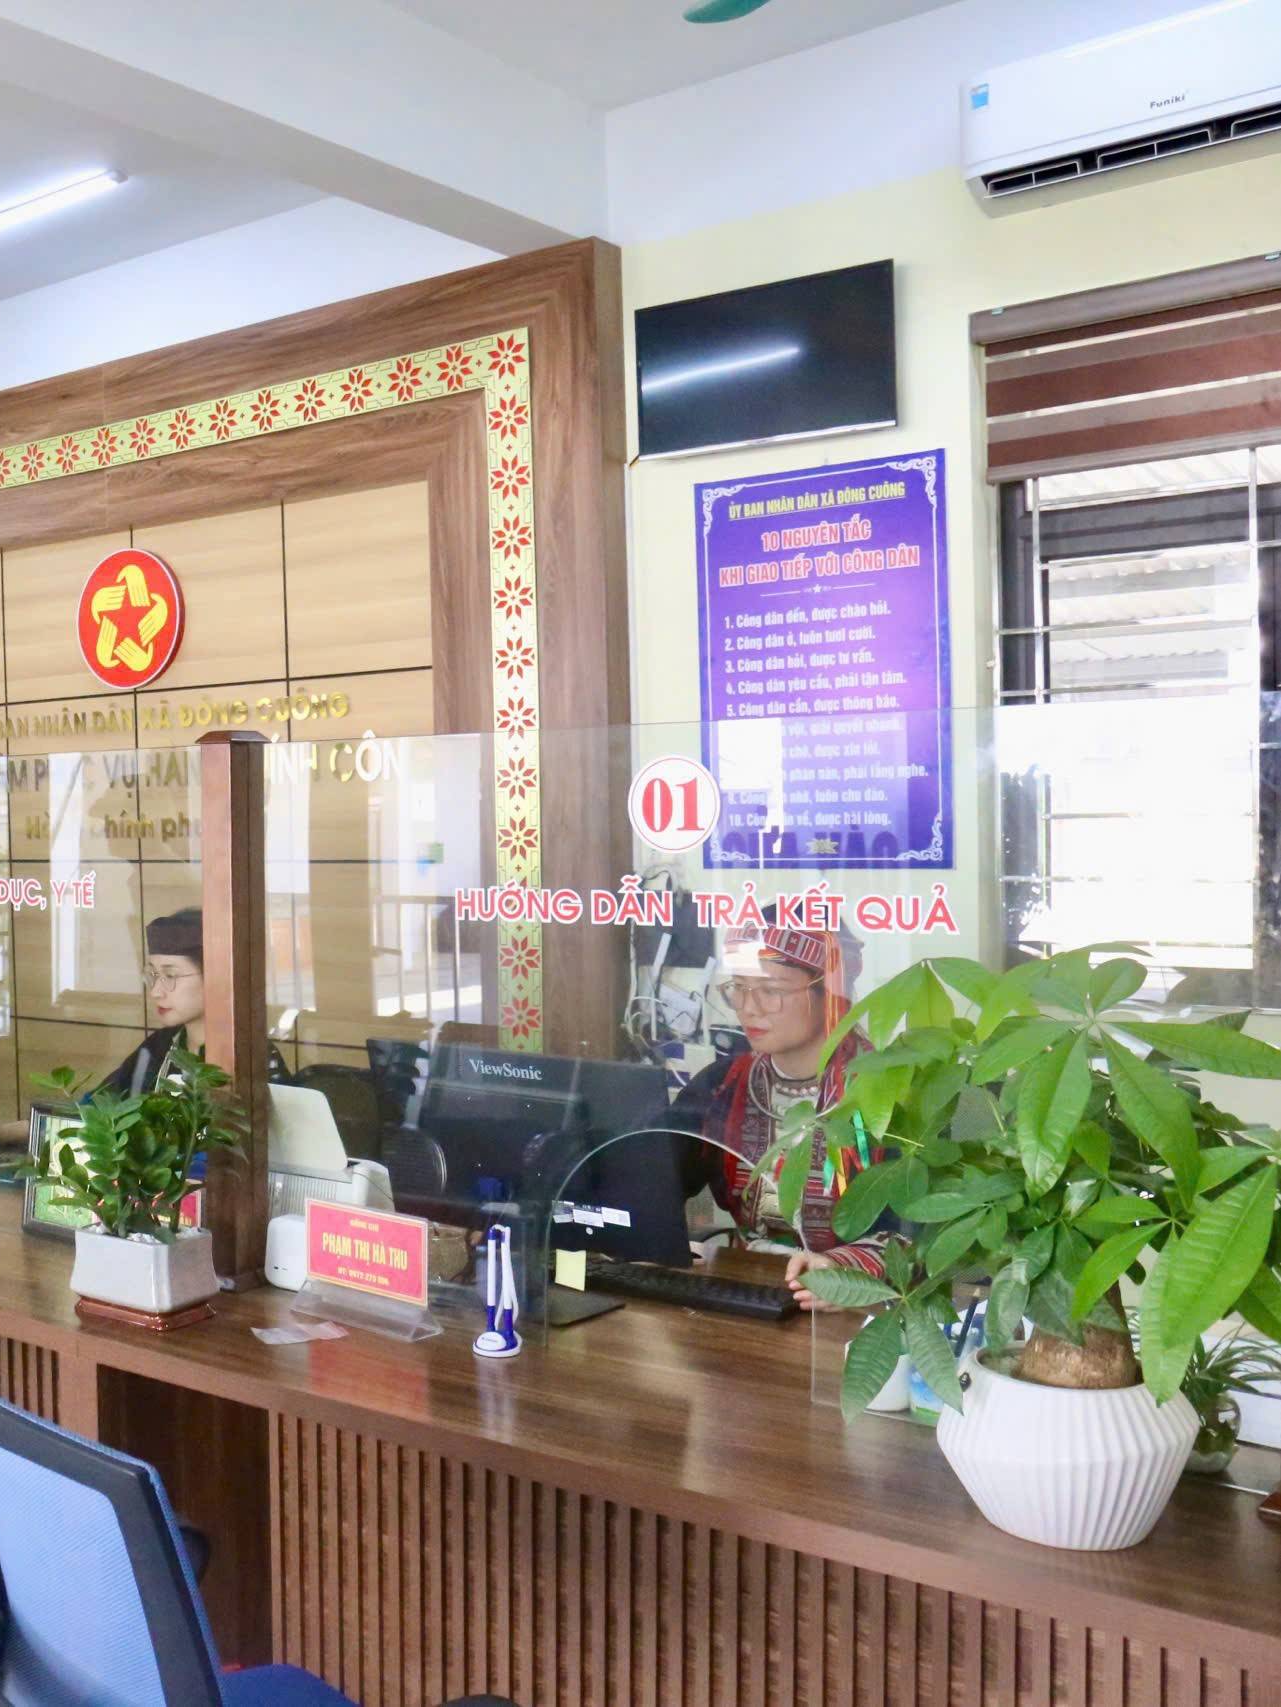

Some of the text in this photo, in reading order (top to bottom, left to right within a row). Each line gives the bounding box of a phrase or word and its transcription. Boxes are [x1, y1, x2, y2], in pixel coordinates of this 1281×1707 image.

[1150, 93, 1185, 109] Funiki
[744, 503, 764, 516] BAN
[767, 496, 795, 514] NHÂN
[797, 492, 818, 510] DÂN
[762, 513, 872, 551] 10 NGUYÊN TẮC
[720, 543, 920, 587] KHI GIAO TIẾP VỚI CÔNG DÂN
[736, 613, 762, 629] Công
[764, 611, 784, 626] dân
[840, 603, 868, 619] chào
[736, 636, 763, 651] Công
[764, 633, 784, 648] dân
[799, 630, 822, 646] luôn
[737, 657, 763, 673] Công
[765, 655, 785, 670] dân
[737, 679, 764, 695] Công
[766, 677, 786, 692] dân
[787, 676, 807, 693] yêu
[33, 706, 88, 738] NHÂN
[92, 702, 134, 734] DÂN
[141, 699, 172, 731] XÃ
[738, 701, 765, 717] Công
[767, 699, 786, 715] dân
[843, 694, 874, 712] thông
[642, 777, 705, 834] 01
[50, 879, 69, 907] Y
[71, 870, 97, 909] TẾ
[455, 875, 960, 936] HƯỚNG DẪN TRẢ KẾT QUẢ
[469, 1059, 543, 1081] ViewSonic
[322, 1232, 408, 1271] PHẠM THỊ HÀ THU
